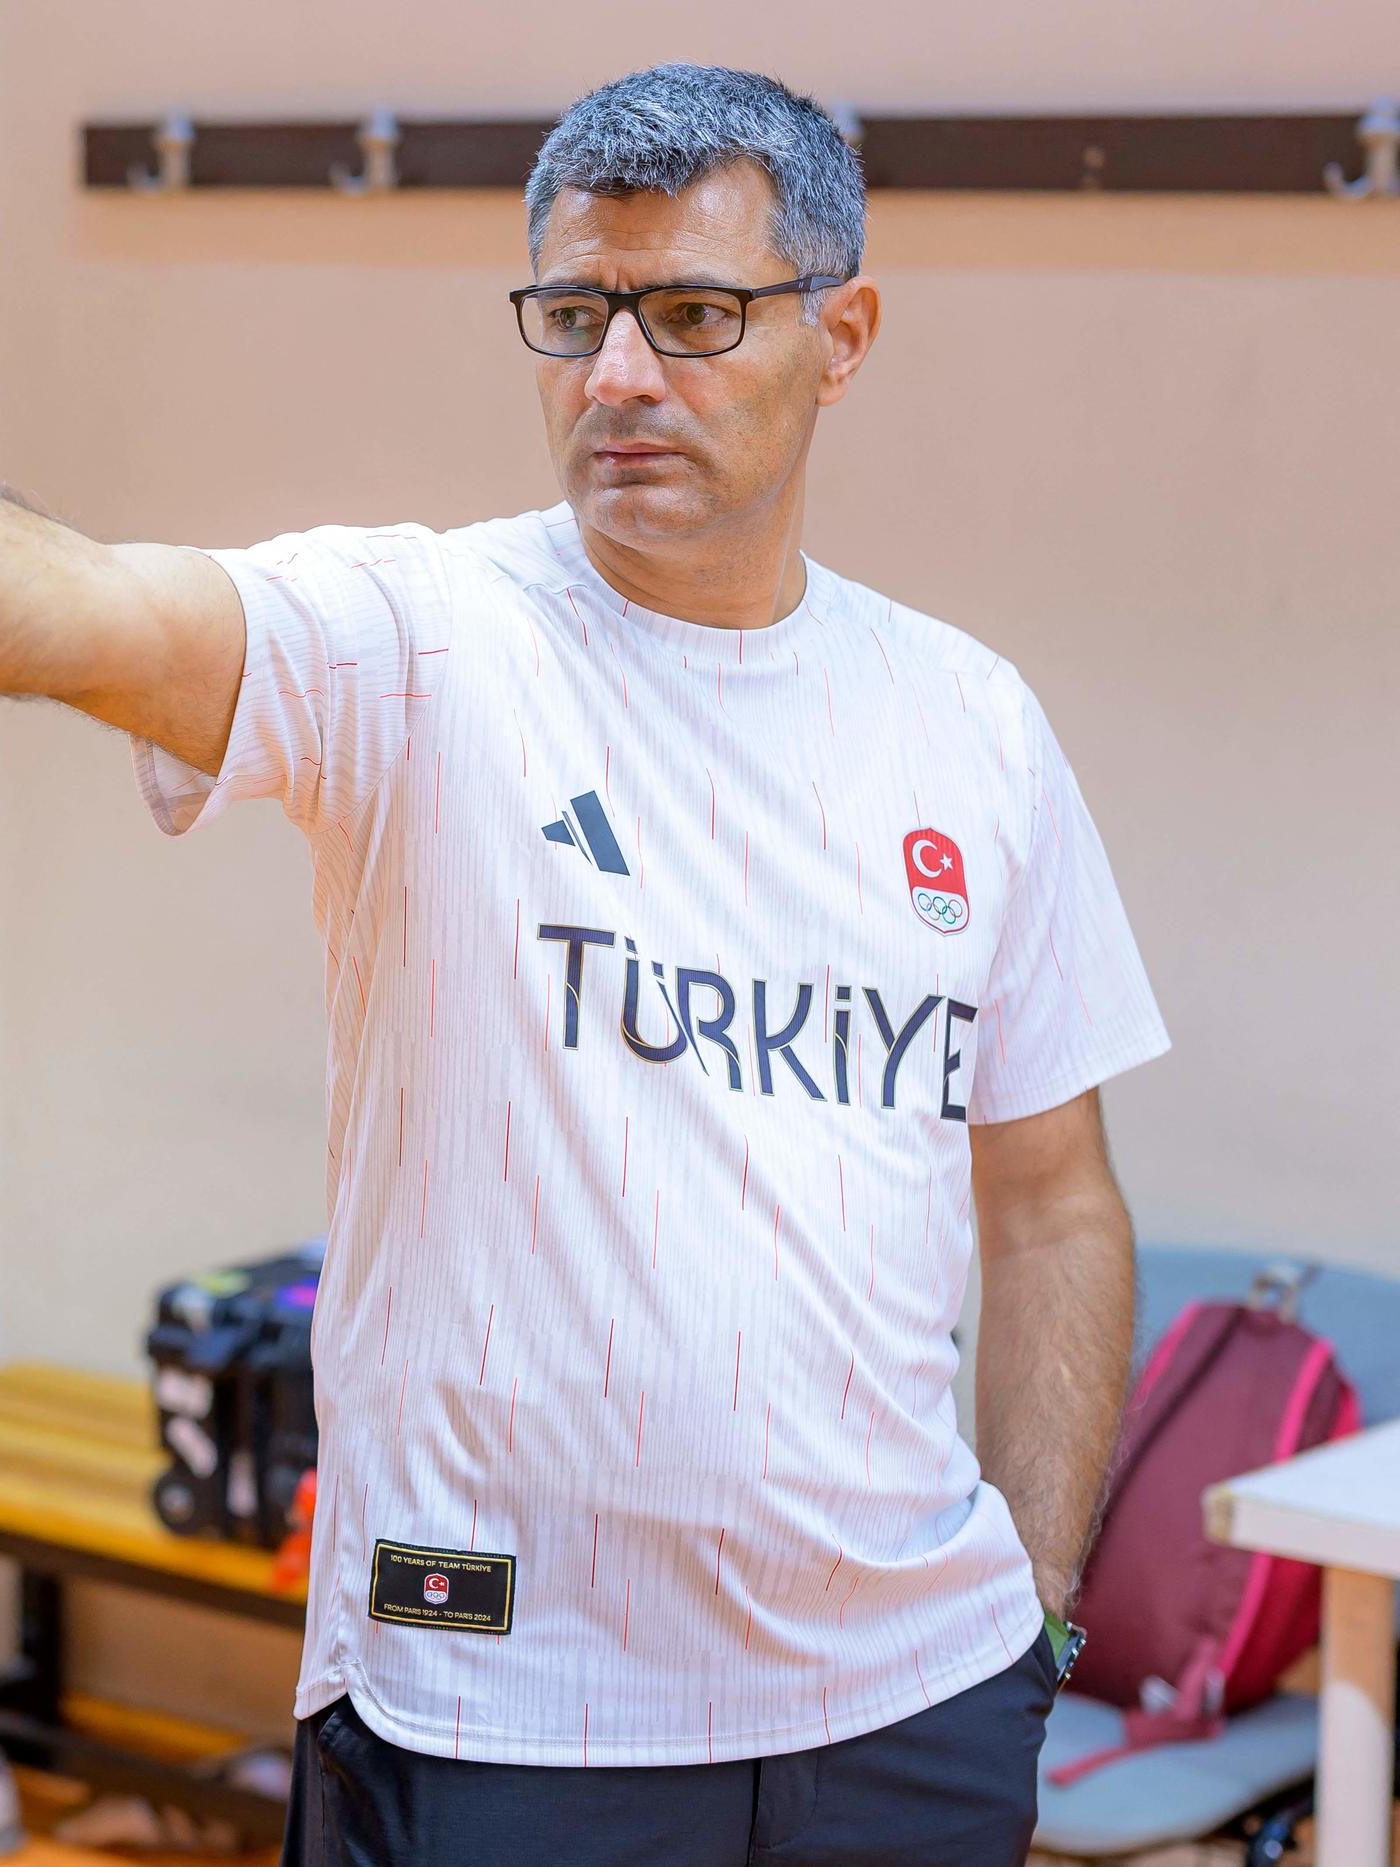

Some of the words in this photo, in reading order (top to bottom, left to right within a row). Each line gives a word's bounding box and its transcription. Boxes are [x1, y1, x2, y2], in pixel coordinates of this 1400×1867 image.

[537, 923, 978, 1122] TÜRKİYE
[391, 1554, 403, 1563] 100
[403, 1556, 425, 1565] YEARS
[438, 1561, 460, 1569] TEAM
[461, 1563, 492, 1573] TÜRKİYE
[383, 1603, 403, 1612] FROM
[404, 1606, 422, 1615] PARIS
[422, 1609, 438, 1617] 1924
[454, 1612, 473, 1620] PARIS
[473, 1613, 491, 1621] 2024
